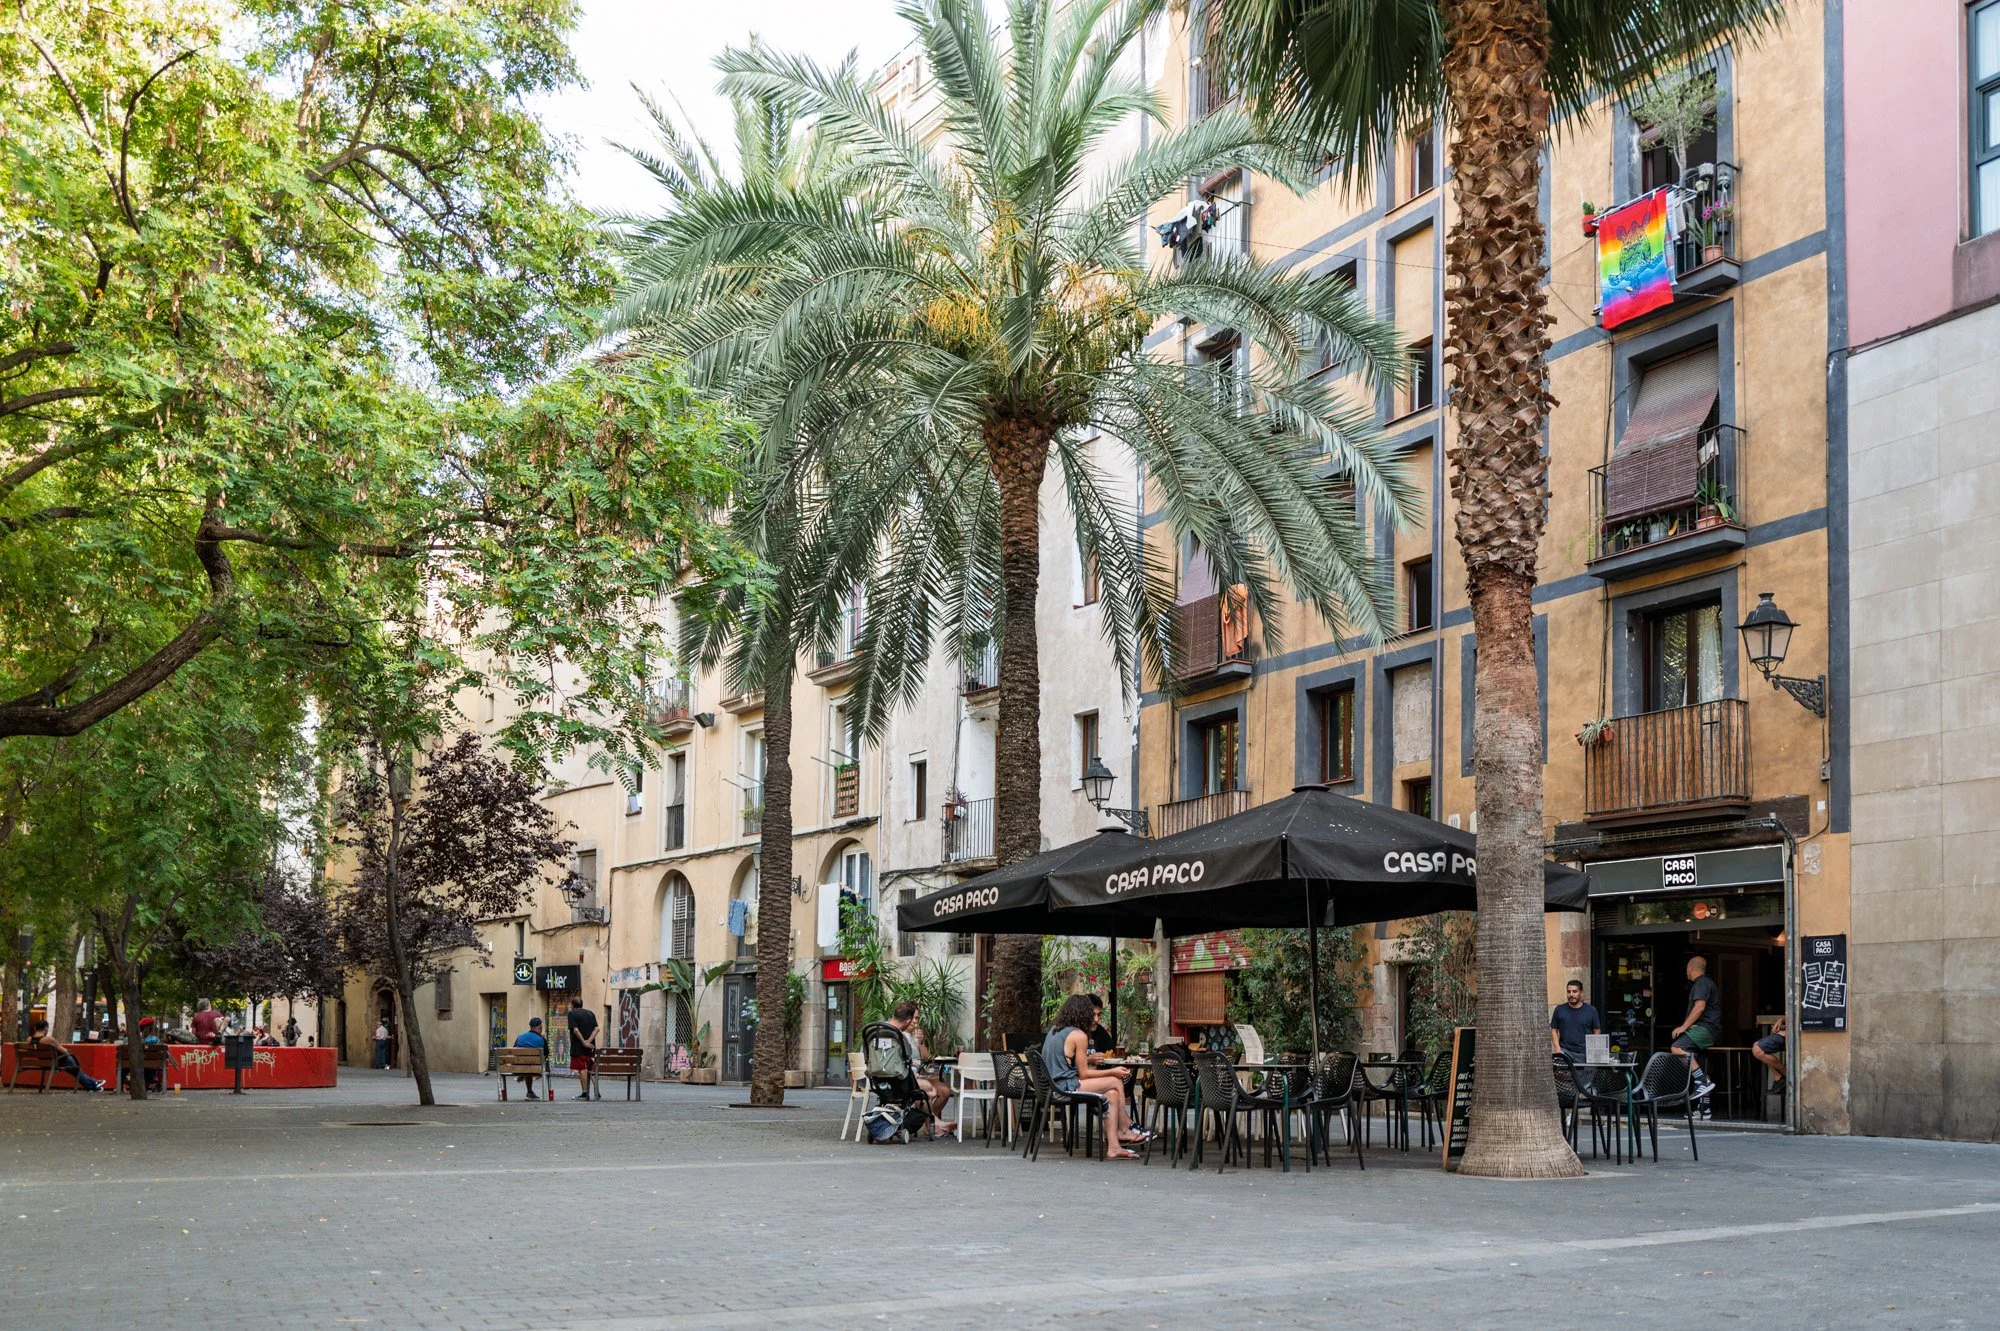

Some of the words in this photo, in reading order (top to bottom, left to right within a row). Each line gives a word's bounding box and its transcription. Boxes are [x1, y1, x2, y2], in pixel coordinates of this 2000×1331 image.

[1383, 851, 1447, 873] CASA
[1664, 859, 1694, 871] CASA
[1105, 867, 1149, 895] CASA
[1151, 860, 1205, 886] PACO
[1665, 872, 1695, 885] PACO
[933, 893, 964, 917] CASA
[965, 886, 999, 909] PACO
